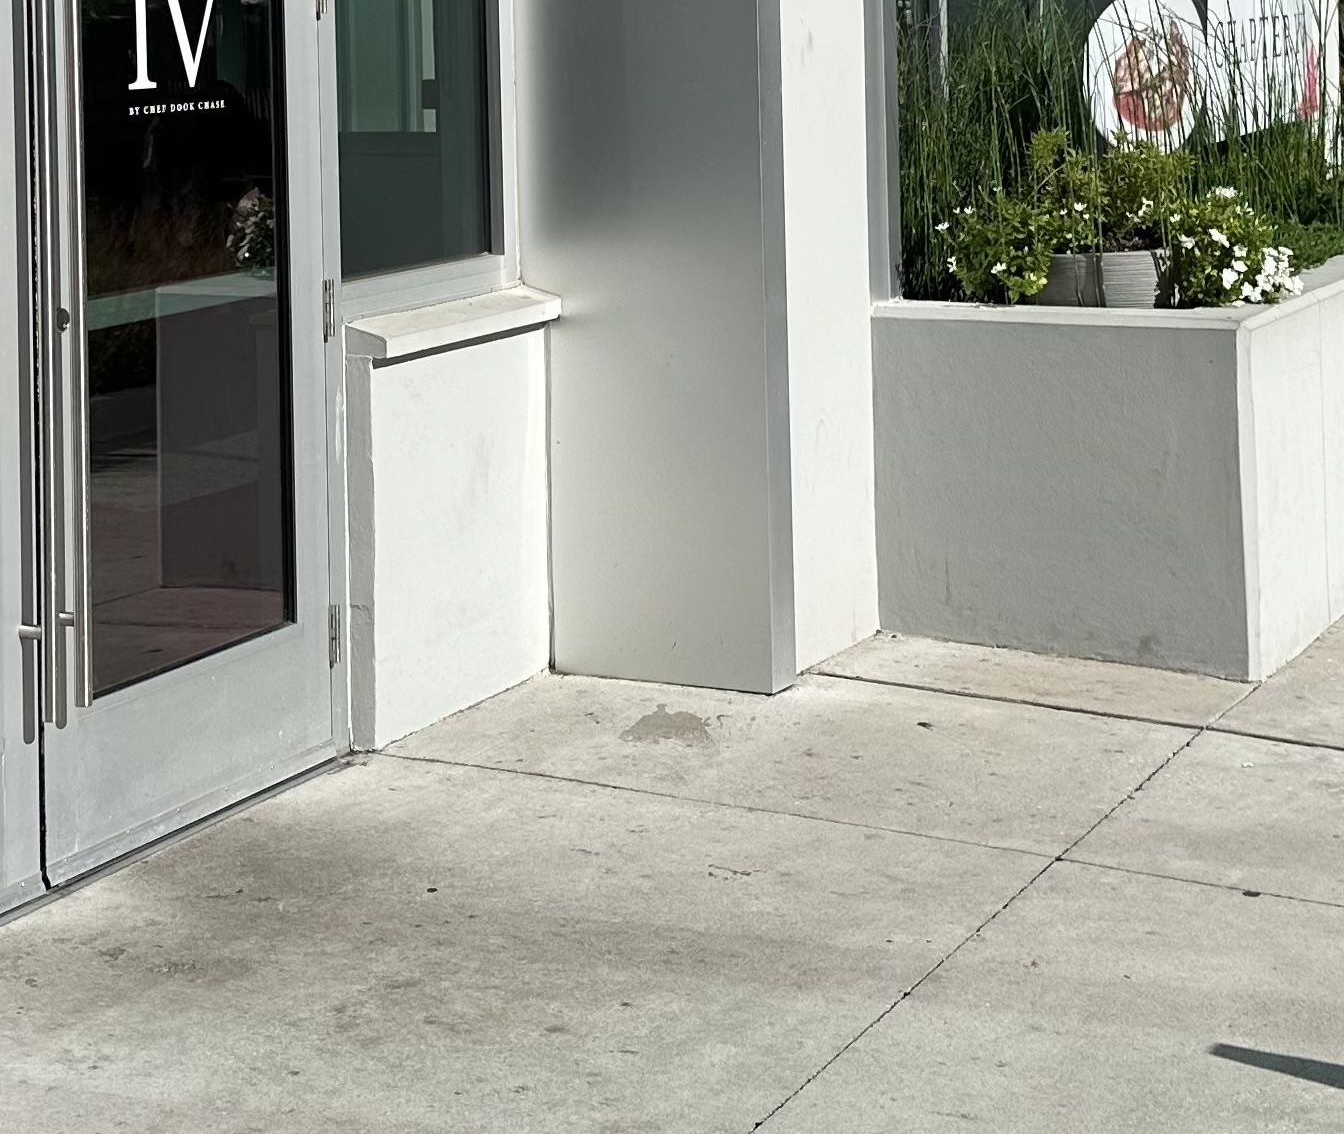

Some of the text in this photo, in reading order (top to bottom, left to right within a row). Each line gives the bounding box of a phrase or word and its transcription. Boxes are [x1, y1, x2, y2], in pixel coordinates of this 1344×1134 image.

[1214, 14, 1291, 68] CHAPTER
[128, 99, 226, 116] BY CHEF DOOK CHASE
